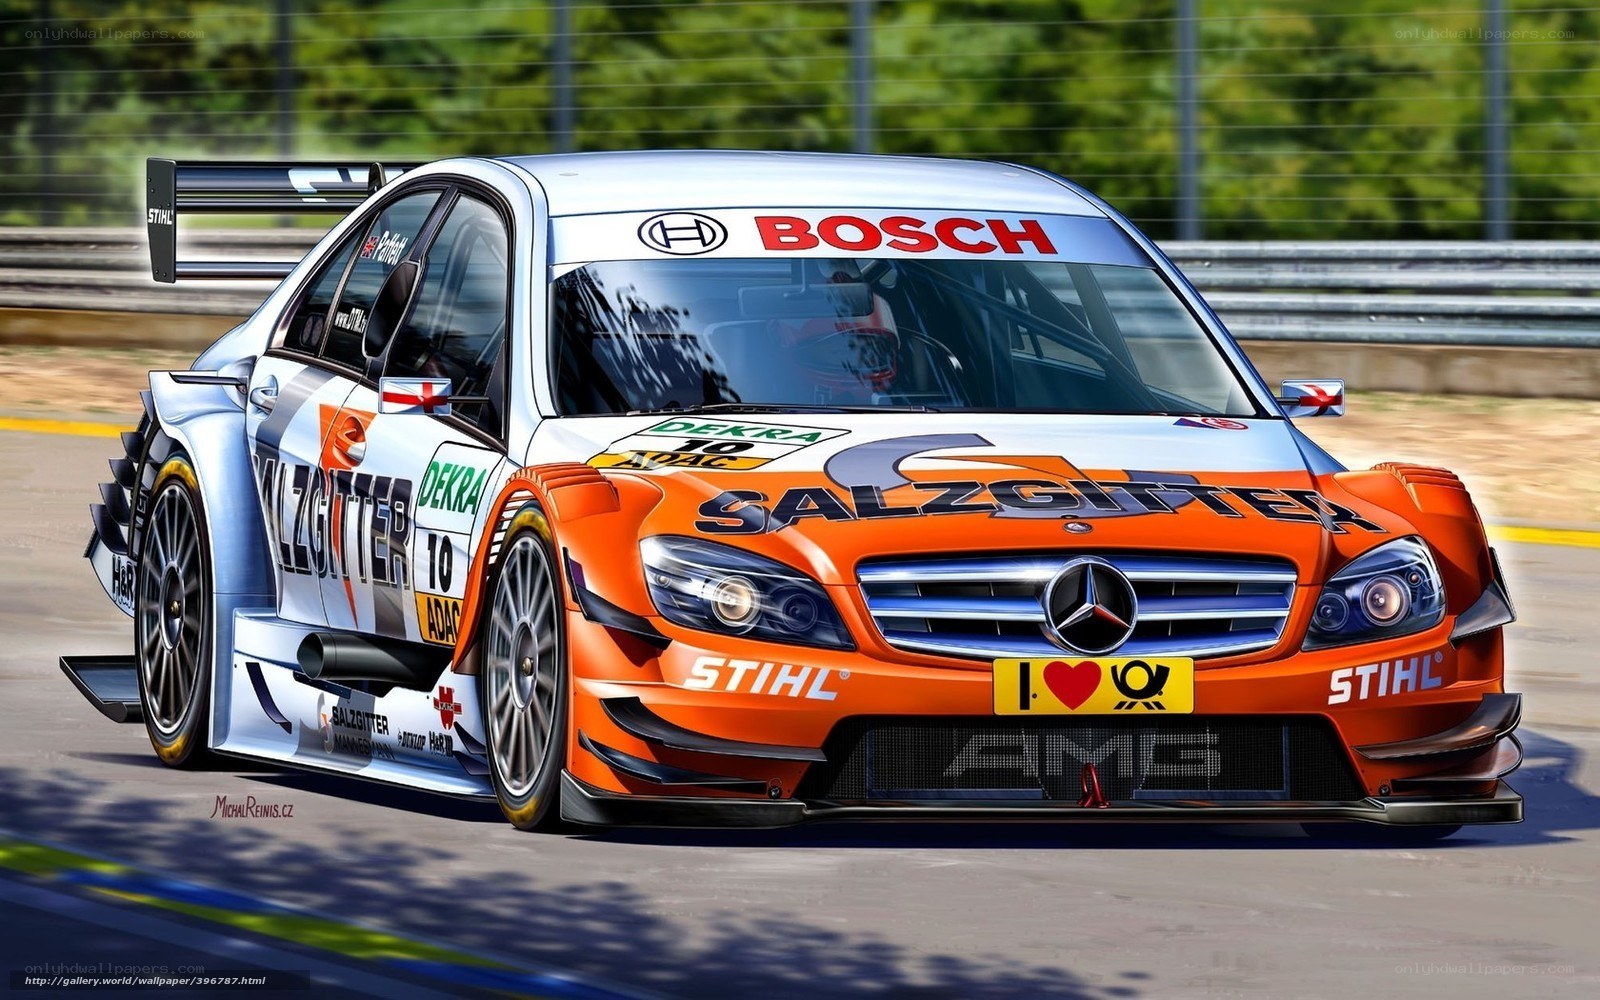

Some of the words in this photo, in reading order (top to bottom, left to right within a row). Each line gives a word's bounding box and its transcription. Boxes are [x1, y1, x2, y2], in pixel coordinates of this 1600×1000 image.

[148, 208, 173, 225] STIHL
[754, 215, 1058, 255] BOSCH
[648, 421, 823, 443] DEKRA
[672, 440, 754, 455] 10
[614, 451, 737, 471] ADAC
[418, 461, 487, 515] DEKRA
[693, 478, 1388, 535] SALZGITTER
[428, 533, 453, 593] 10
[426, 597, 461, 644] ADAC
[332, 706, 389, 736] SALZGITTER
[943, 733, 1221, 778] AMG
